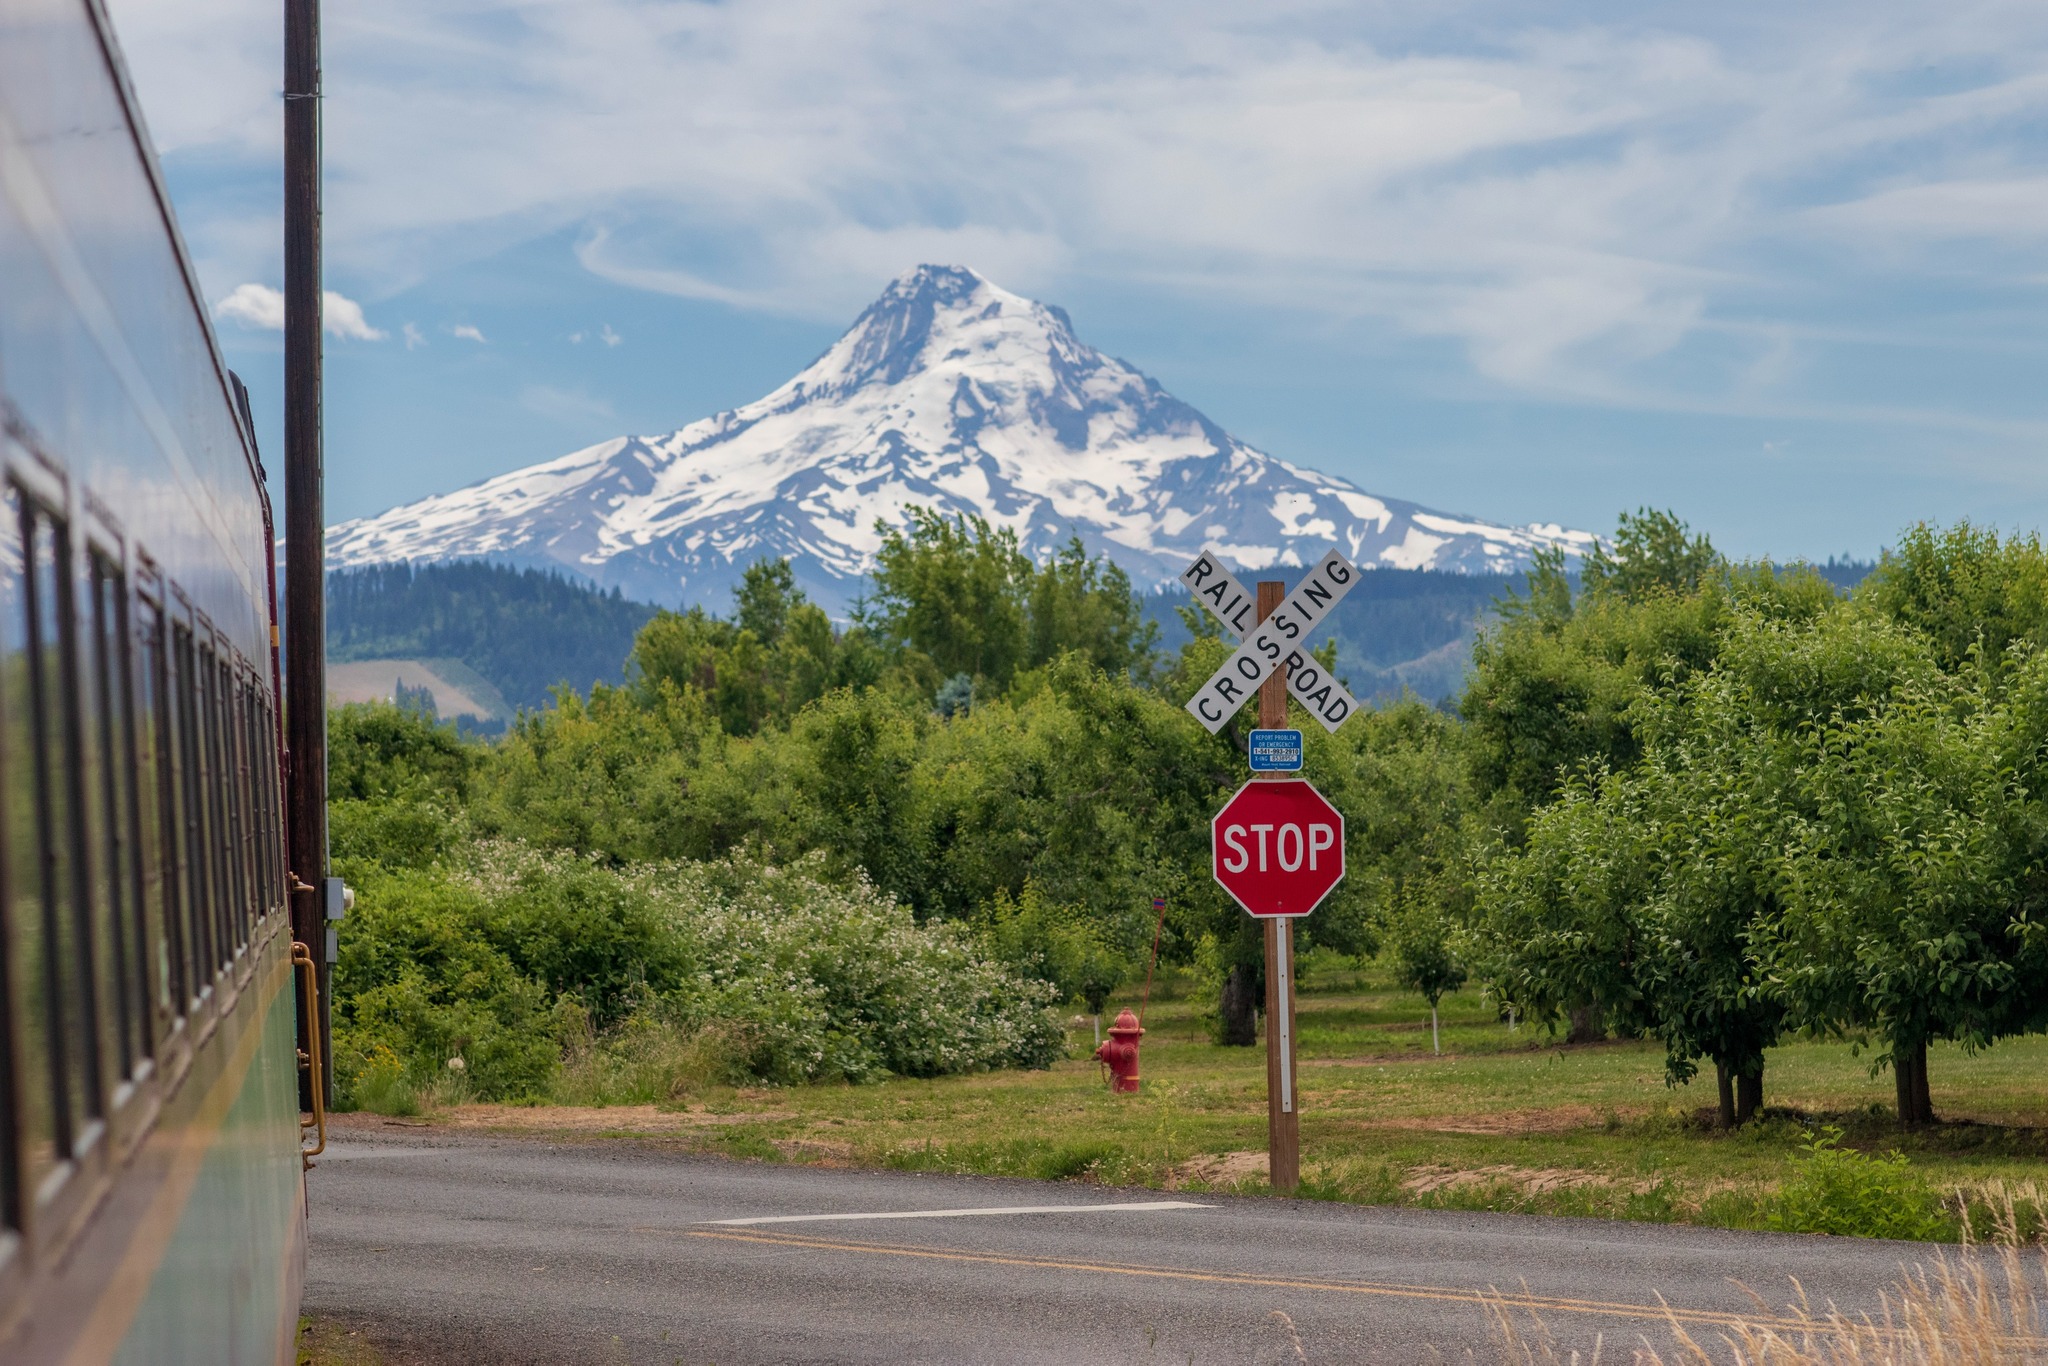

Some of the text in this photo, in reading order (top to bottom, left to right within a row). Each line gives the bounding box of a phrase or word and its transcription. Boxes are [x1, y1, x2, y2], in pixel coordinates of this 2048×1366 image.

[1186, 557, 1349, 723] RAIL ROAD
[1198, 560, 1350, 722] CROSSING
[1223, 822, 1334, 873] STOP
